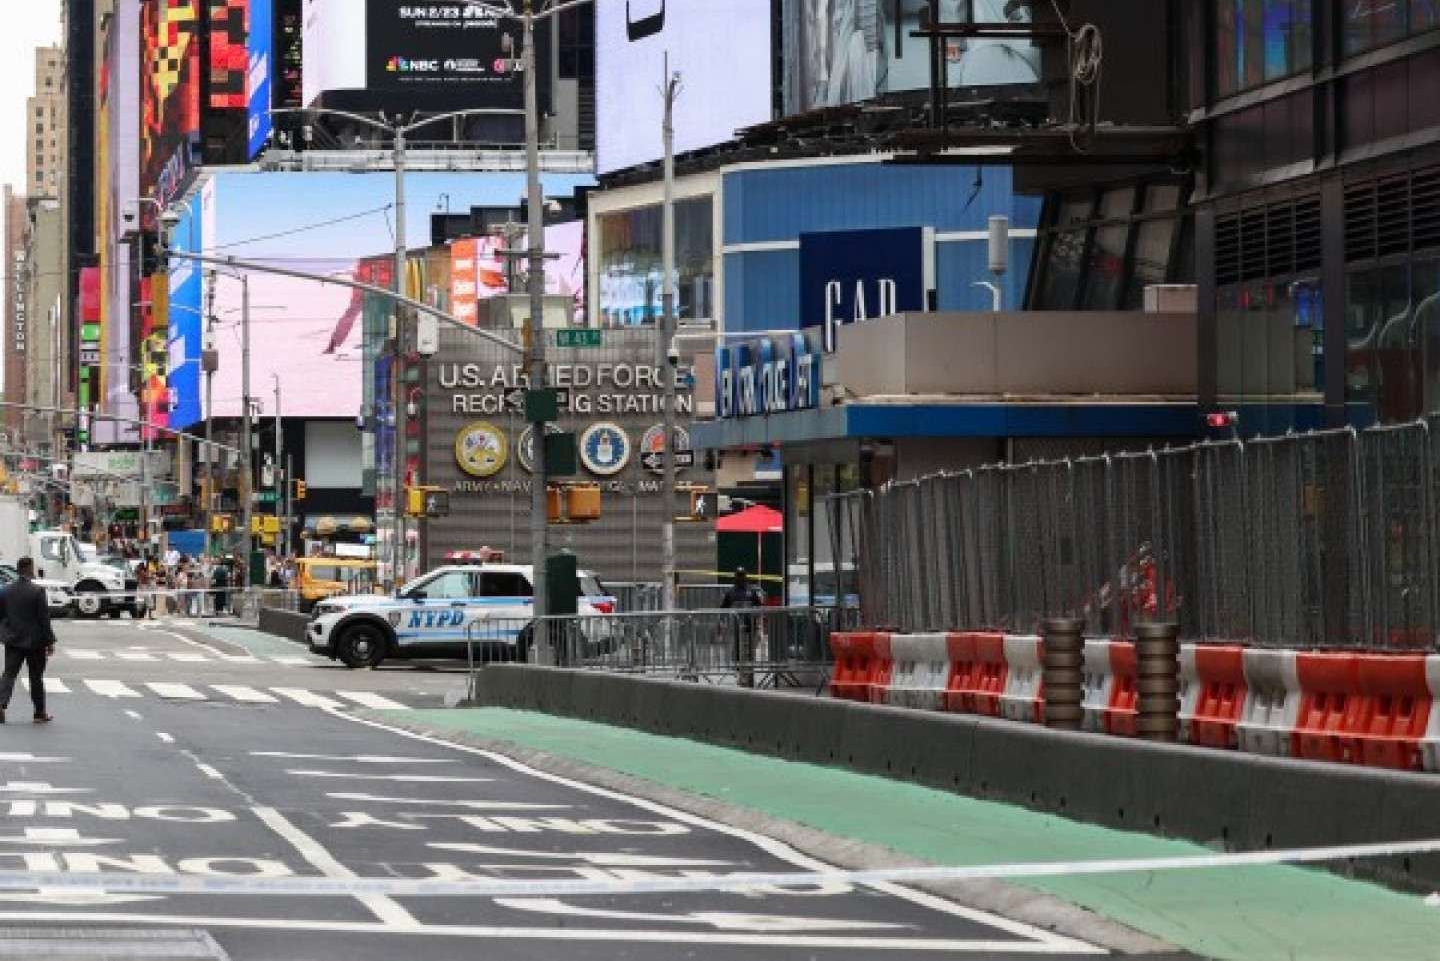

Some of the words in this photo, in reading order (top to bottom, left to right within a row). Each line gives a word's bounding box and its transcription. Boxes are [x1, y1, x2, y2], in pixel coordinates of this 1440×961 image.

[410, 60, 440, 71] NBC
[438, 362, 485, 387] U.S.
[491, 363, 596, 387] ARED
[407, 609, 464, 628] NYPD
